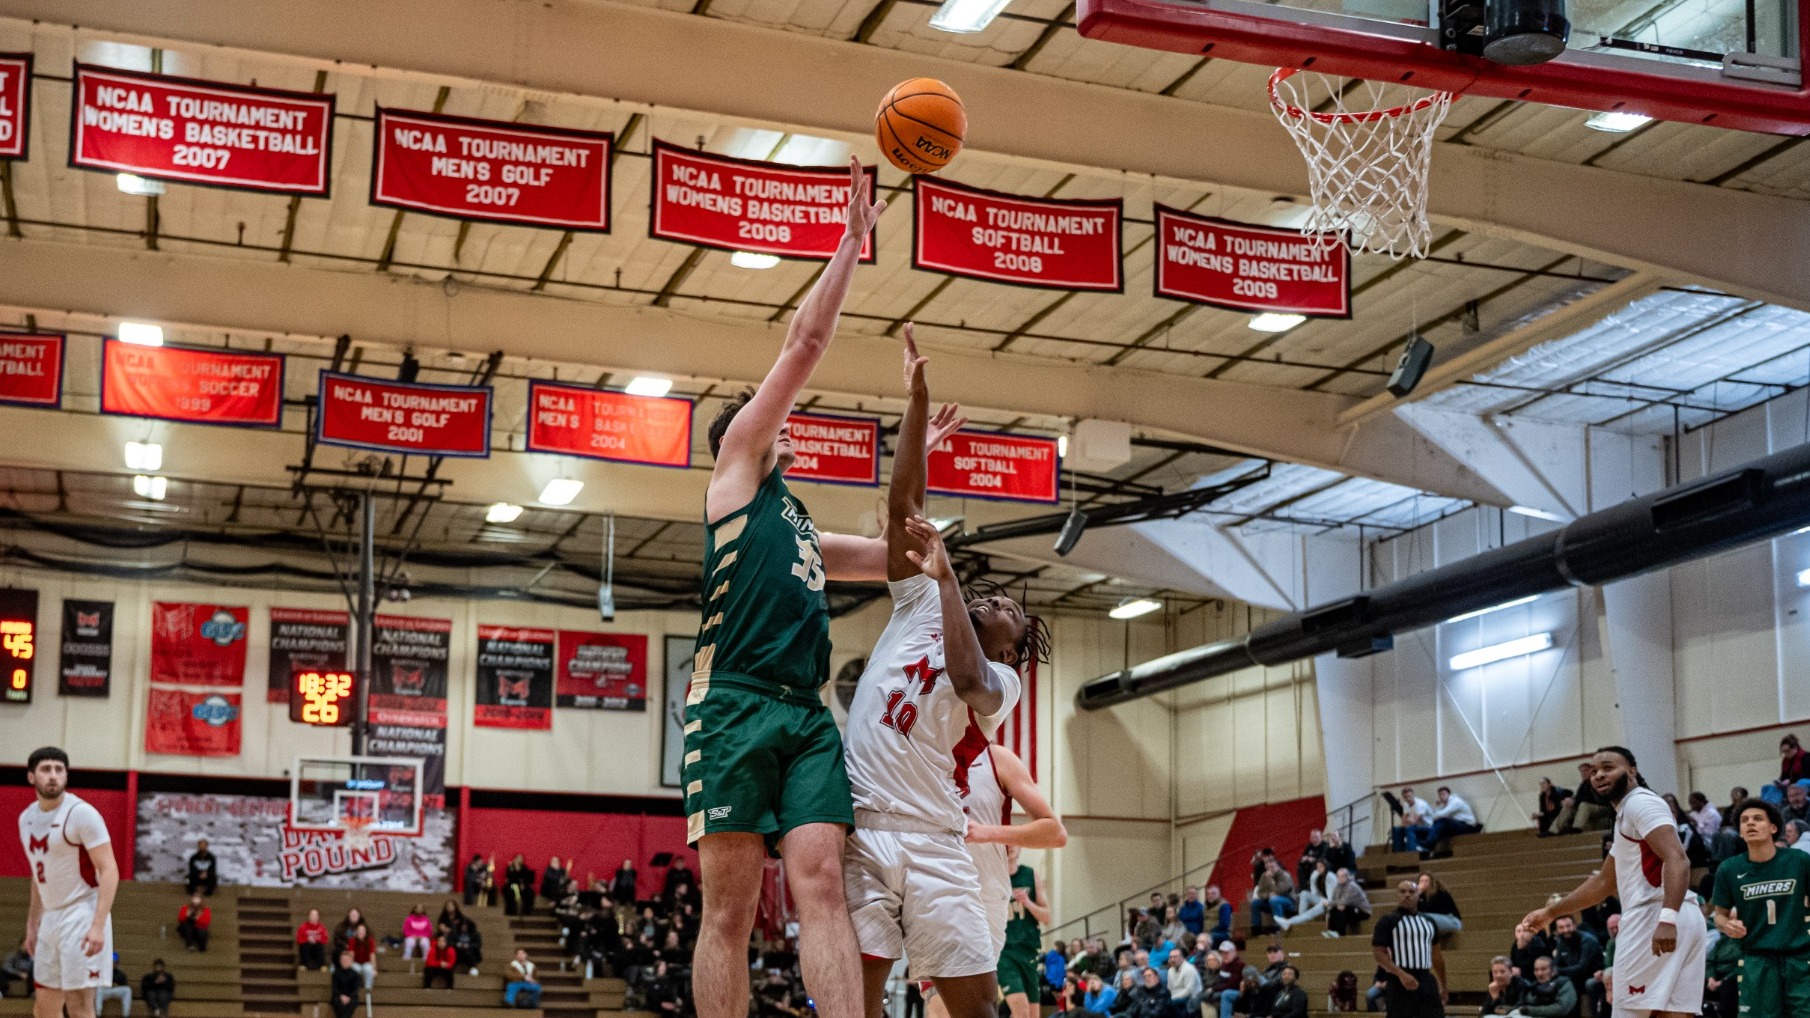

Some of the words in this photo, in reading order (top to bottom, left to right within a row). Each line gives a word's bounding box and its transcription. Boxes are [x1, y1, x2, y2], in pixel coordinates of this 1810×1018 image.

[97, 86, 153, 113] NCAA
[166, 95, 307, 130] TOURNAMENT
[185, 123, 319, 155] BASKETBALL
[394, 128, 447, 153] NCAA
[459, 136, 590, 168] TOURNAMENT
[915, 135, 952, 160] NCAA
[172, 145, 230, 170] 2007
[432, 156, 490, 181] MEN'S
[502, 164, 553, 186] GOLF
[672, 164, 721, 191] NCAA
[466, 184, 520, 206] 2007
[932, 195, 977, 223] NCAA
[986, 207, 1104, 235] TOURNAMENT
[738, 221, 791, 243] 2008
[972, 227, 1064, 255] SOFTBALL
[1174, 226, 1216, 250] NCAA
[1223, 235, 1331, 263] TOURNAMENT
[994, 252, 1042, 273] 2008
[1238, 259, 1338, 282] BASKETBALL
[1233, 278, 1278, 298] 2009
[199, 381, 260, 397] SOCCER
[334, 385, 373, 404] NCAA
[382, 392, 478, 412] TOURNAMENT
[539, 394, 575, 411] NCAA
[411, 412, 450, 428] GOLF
[388, 426, 424, 442] 2001
[591, 434, 626, 449] 2004
[968, 441, 1049, 461] TOURNAMENT
[793, 456, 819, 470] 004
[954, 457, 1017, 474] SOFTBALL
[969, 473, 1002, 488] 2004
[791, 534, 826, 591] 35
[279, 624, 339, 637] NATIONAL
[382, 629, 441, 645] NATIONAL
[4, 634, 33, 659] 45
[272, 637, 345, 652] CHAMPIONS
[373, 643, 447, 659] CHAMPIONS
[479, 654, 551, 669] CHAMPIONS
[13, 669, 26, 689] 0
[299, 673, 352, 697] 18:32
[303, 693, 339, 723] 26
[879, 690, 918, 739] 10
[377, 726, 438, 741] NATIONAL
[368, 739, 444, 756] CHAMPIONS
[283, 838, 392, 877] POUND
[36, 861, 46, 883] 2
[1746, 881, 1792, 897] MINERS
[1766, 899, 1776, 925] 1
